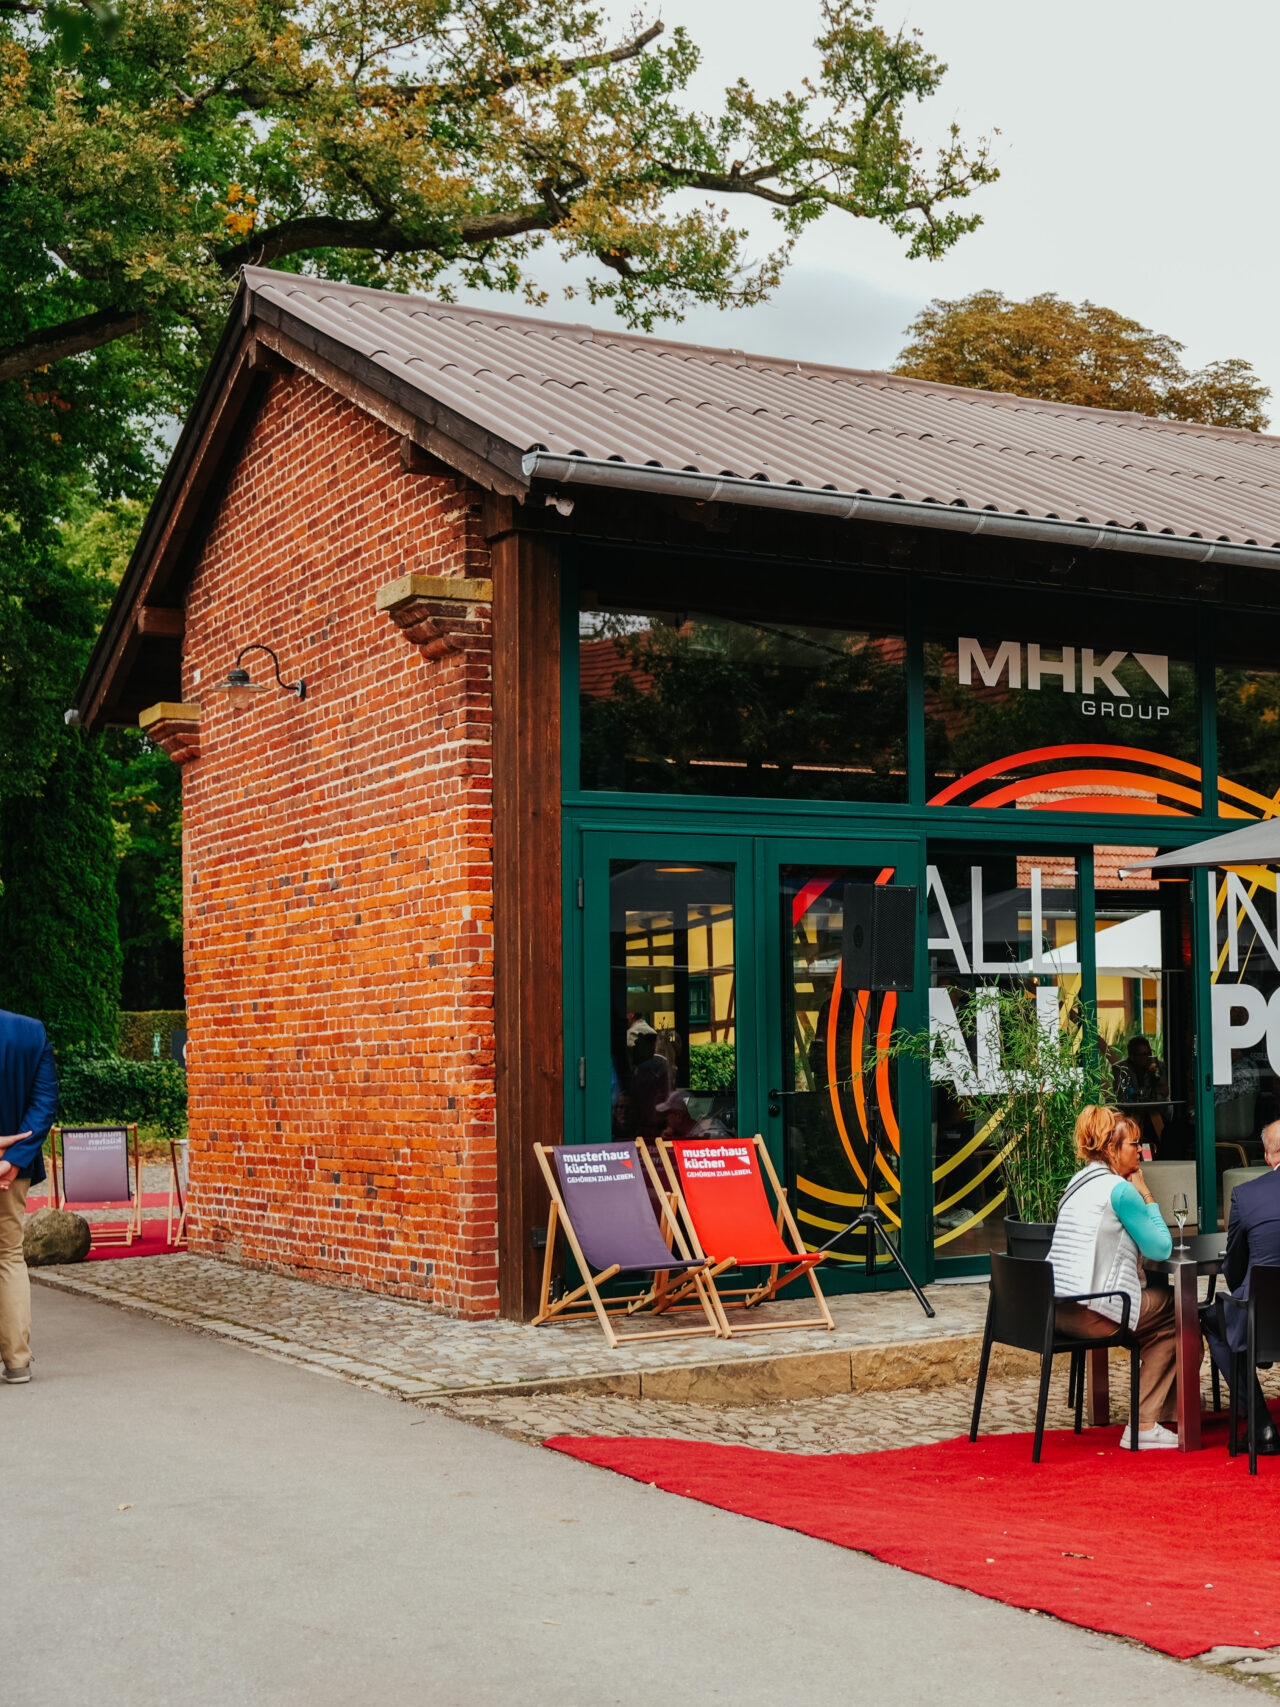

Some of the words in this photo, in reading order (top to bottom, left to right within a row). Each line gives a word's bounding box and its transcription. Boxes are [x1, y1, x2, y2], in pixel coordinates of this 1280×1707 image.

[958, 637, 1131, 698] MHK
[1081, 700, 1170, 720] GROUP
[563, 1150, 630, 1163] musterhaus
[682, 1146, 748, 1158] musterhaus
[564, 1162, 607, 1175] küchen
[684, 1156, 725, 1169] küchen
[567, 1175, 597, 1184] GEHÖREN
[598, 1174, 613, 1182] ZUM
[686, 1170, 717, 1178] GEHÖREN
